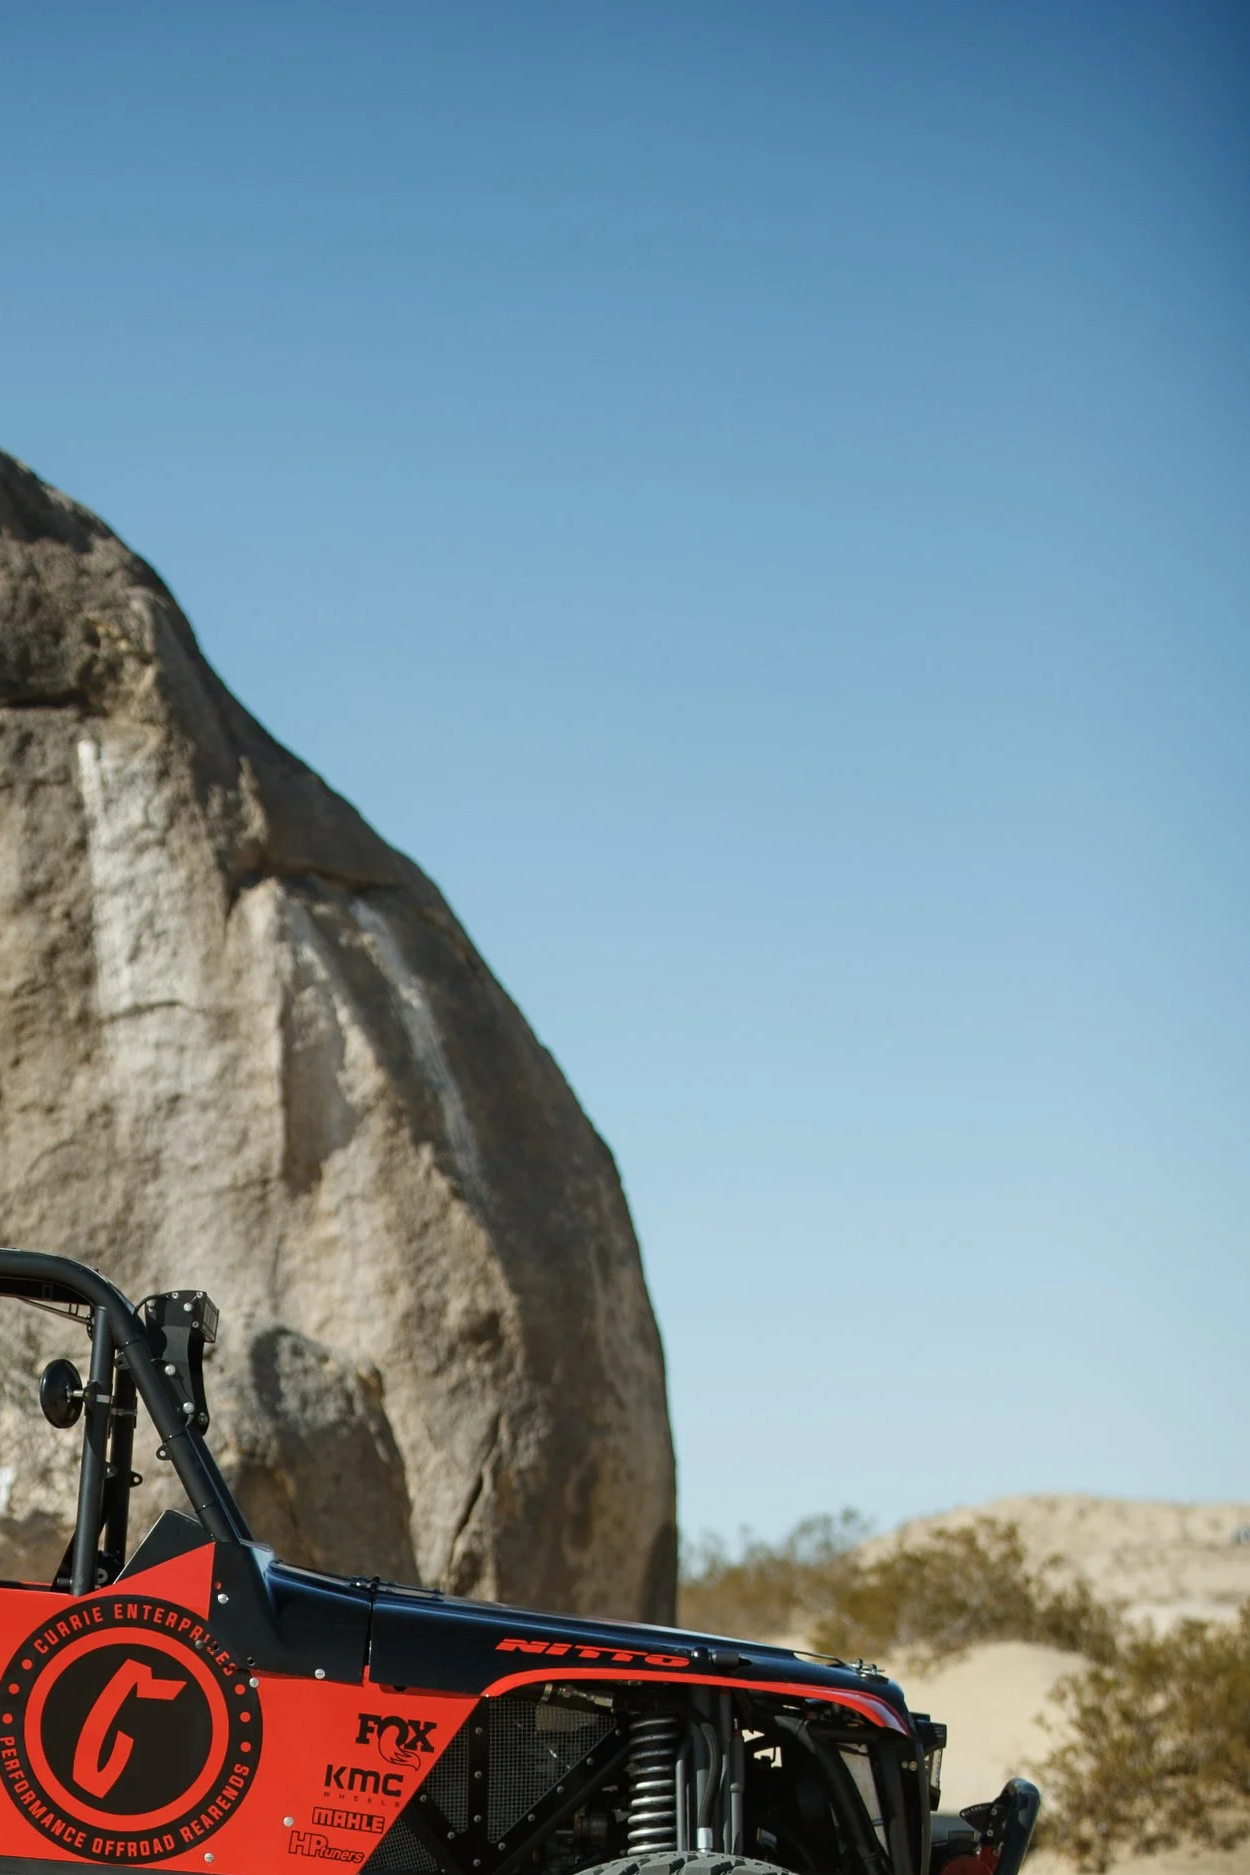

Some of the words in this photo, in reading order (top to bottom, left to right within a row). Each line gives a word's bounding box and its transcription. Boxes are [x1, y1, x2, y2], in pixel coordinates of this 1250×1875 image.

[33, 1606, 104, 1655] CURRIE
[494, 1638, 690, 1667] NITTO
[355, 1713, 437, 1770] FOX
[0, 1736, 86, 1848] PERFORMANCE
[91, 1834, 175, 1857] OFFROAD
[180, 1764, 250, 1843] REARENDS
[311, 1806, 385, 1834] MAHLE
